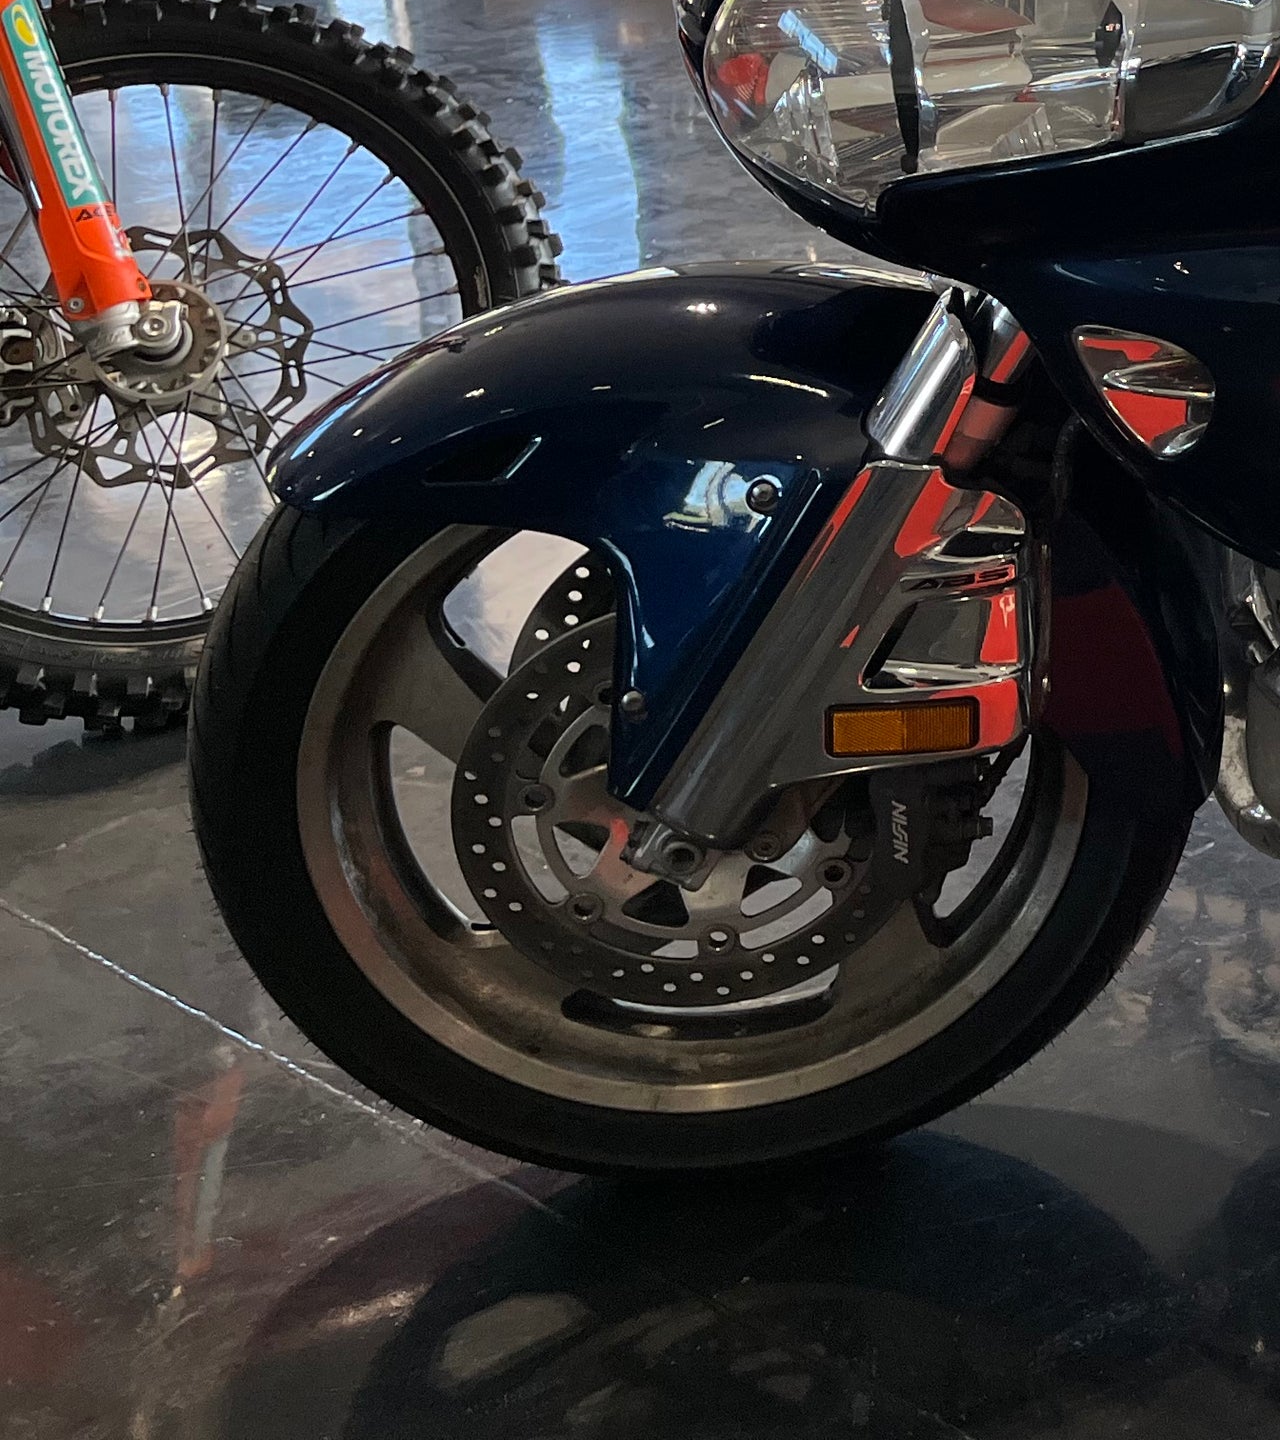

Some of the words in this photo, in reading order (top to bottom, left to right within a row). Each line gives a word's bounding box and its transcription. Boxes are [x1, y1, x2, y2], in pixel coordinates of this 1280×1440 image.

[23, 50, 99, 200] MOTOREX
[906, 566, 1010, 591] ABS
[890, 799, 909, 864] NISSIN
